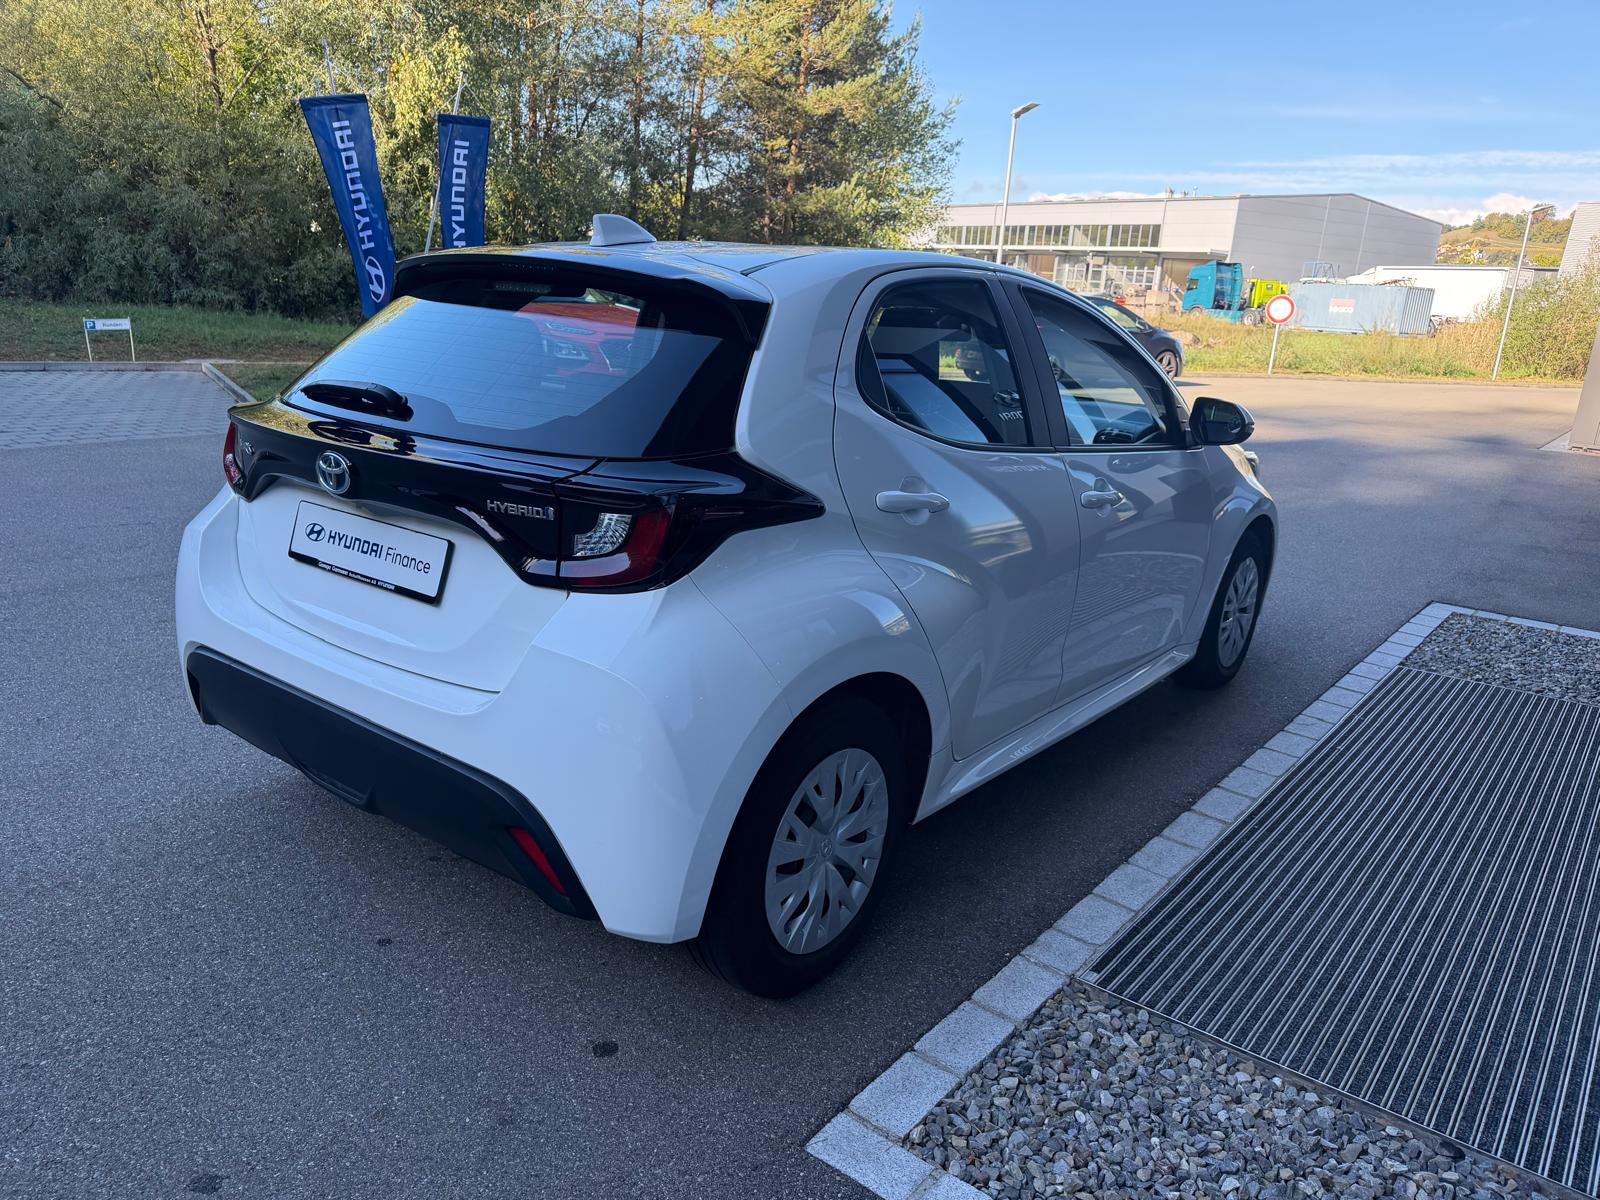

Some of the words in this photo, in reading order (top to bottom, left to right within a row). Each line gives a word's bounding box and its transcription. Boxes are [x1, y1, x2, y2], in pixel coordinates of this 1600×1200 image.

[332, 120, 375, 250] HYUNDAI
[486, 499, 544, 519] HYBRID
[327, 529, 384, 559] HYUNDAI
[384, 546, 431, 574] Finance
